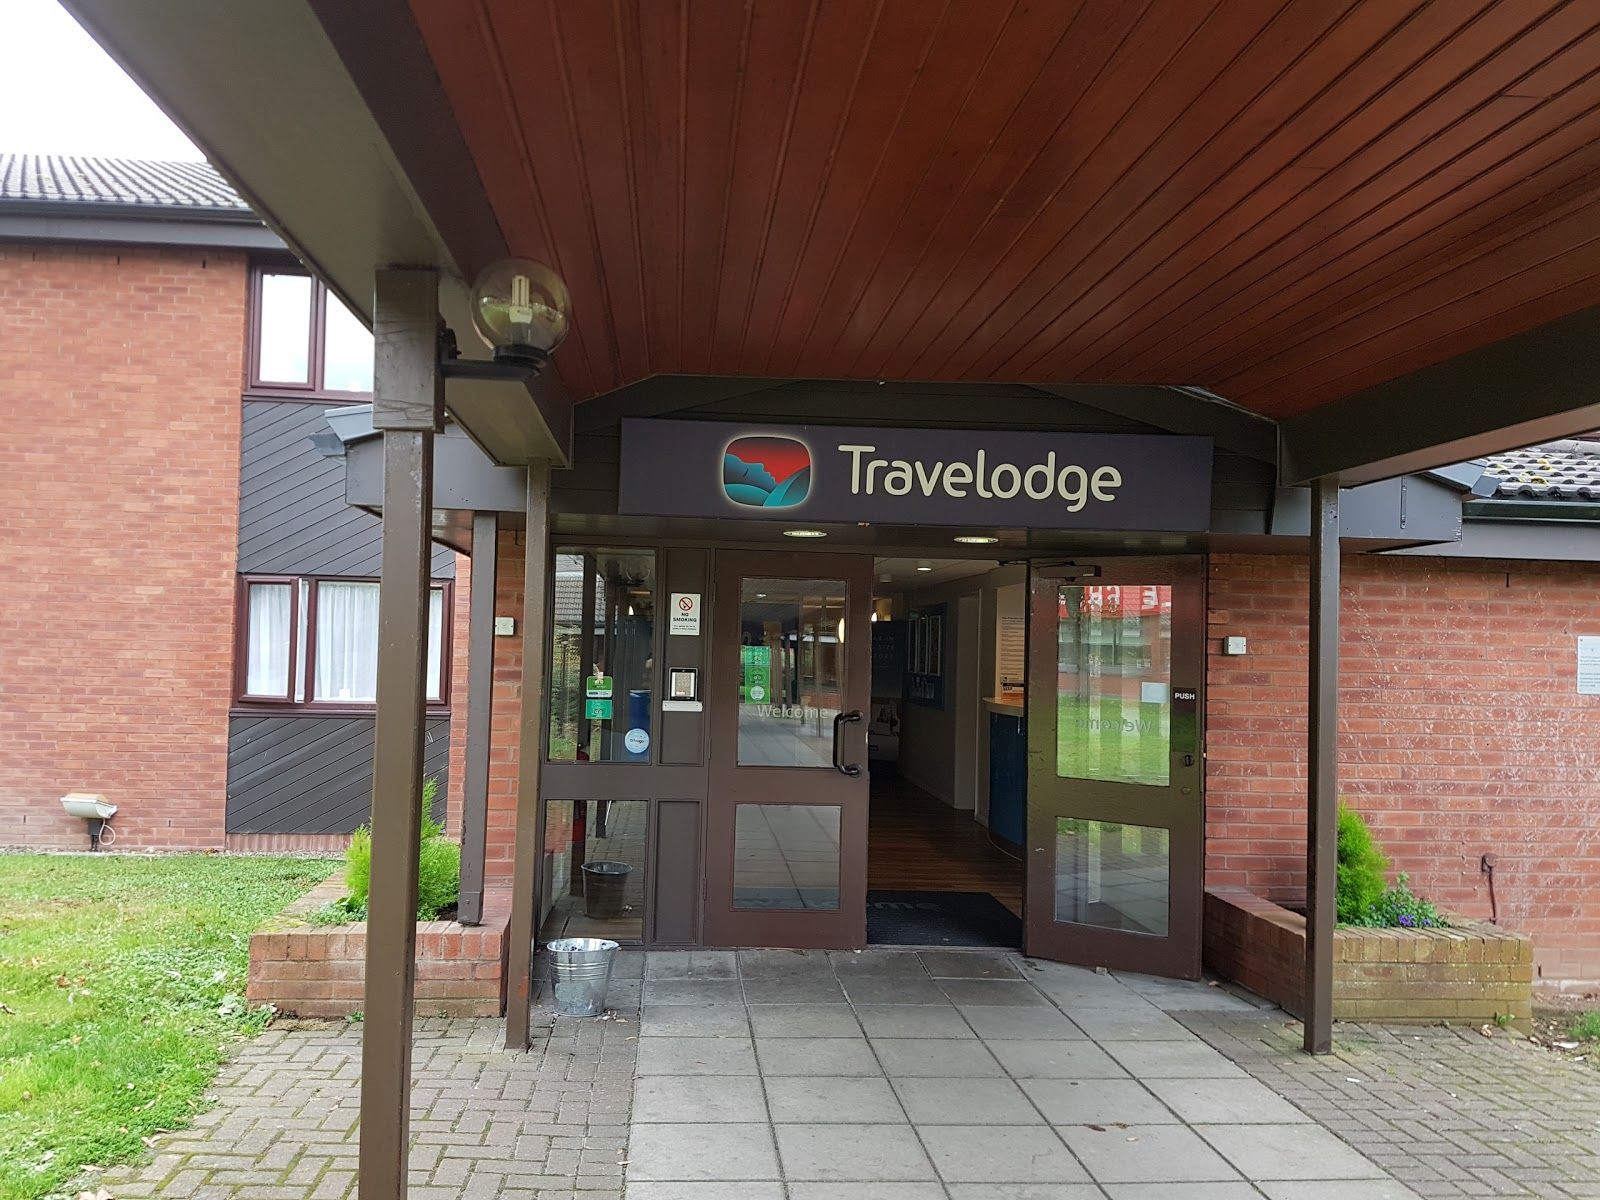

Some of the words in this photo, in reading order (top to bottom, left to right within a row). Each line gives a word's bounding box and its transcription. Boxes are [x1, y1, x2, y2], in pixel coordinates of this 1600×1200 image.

[838, 444, 1123, 513] Travelodge
[1174, 692, 1195, 700] PUSH
[757, 704, 829, 719] Welcome
